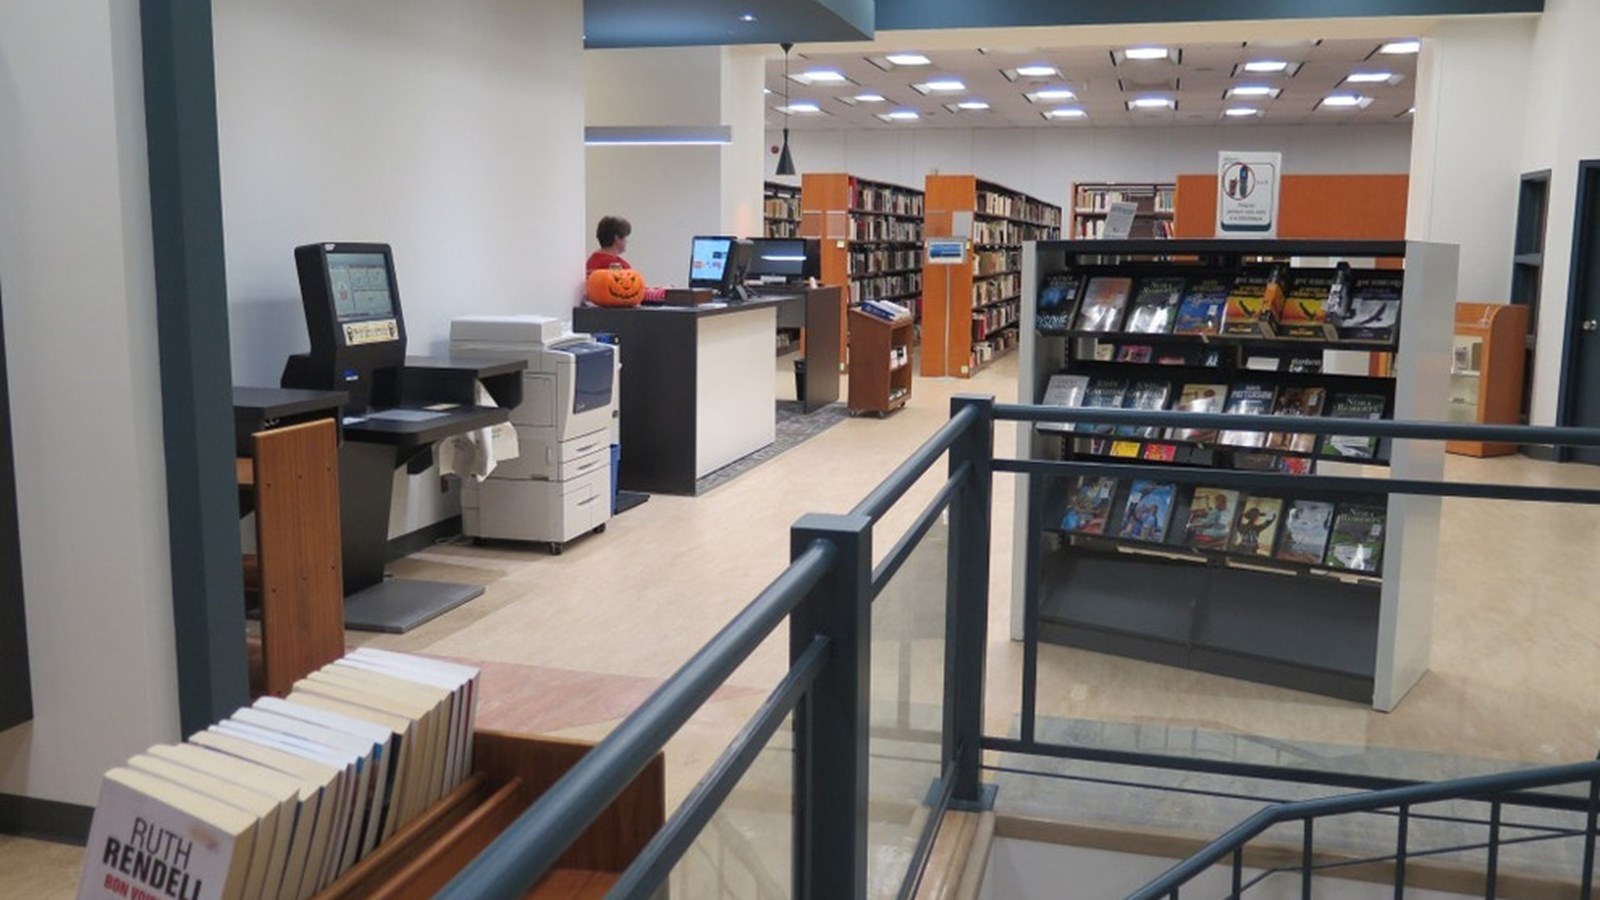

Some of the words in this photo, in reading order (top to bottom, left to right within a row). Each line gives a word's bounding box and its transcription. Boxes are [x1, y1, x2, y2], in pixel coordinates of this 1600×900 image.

[1231, 389, 1273, 400] PATTERSON
[130, 817, 192, 870] RUTH
[104, 874, 129, 897] BON
